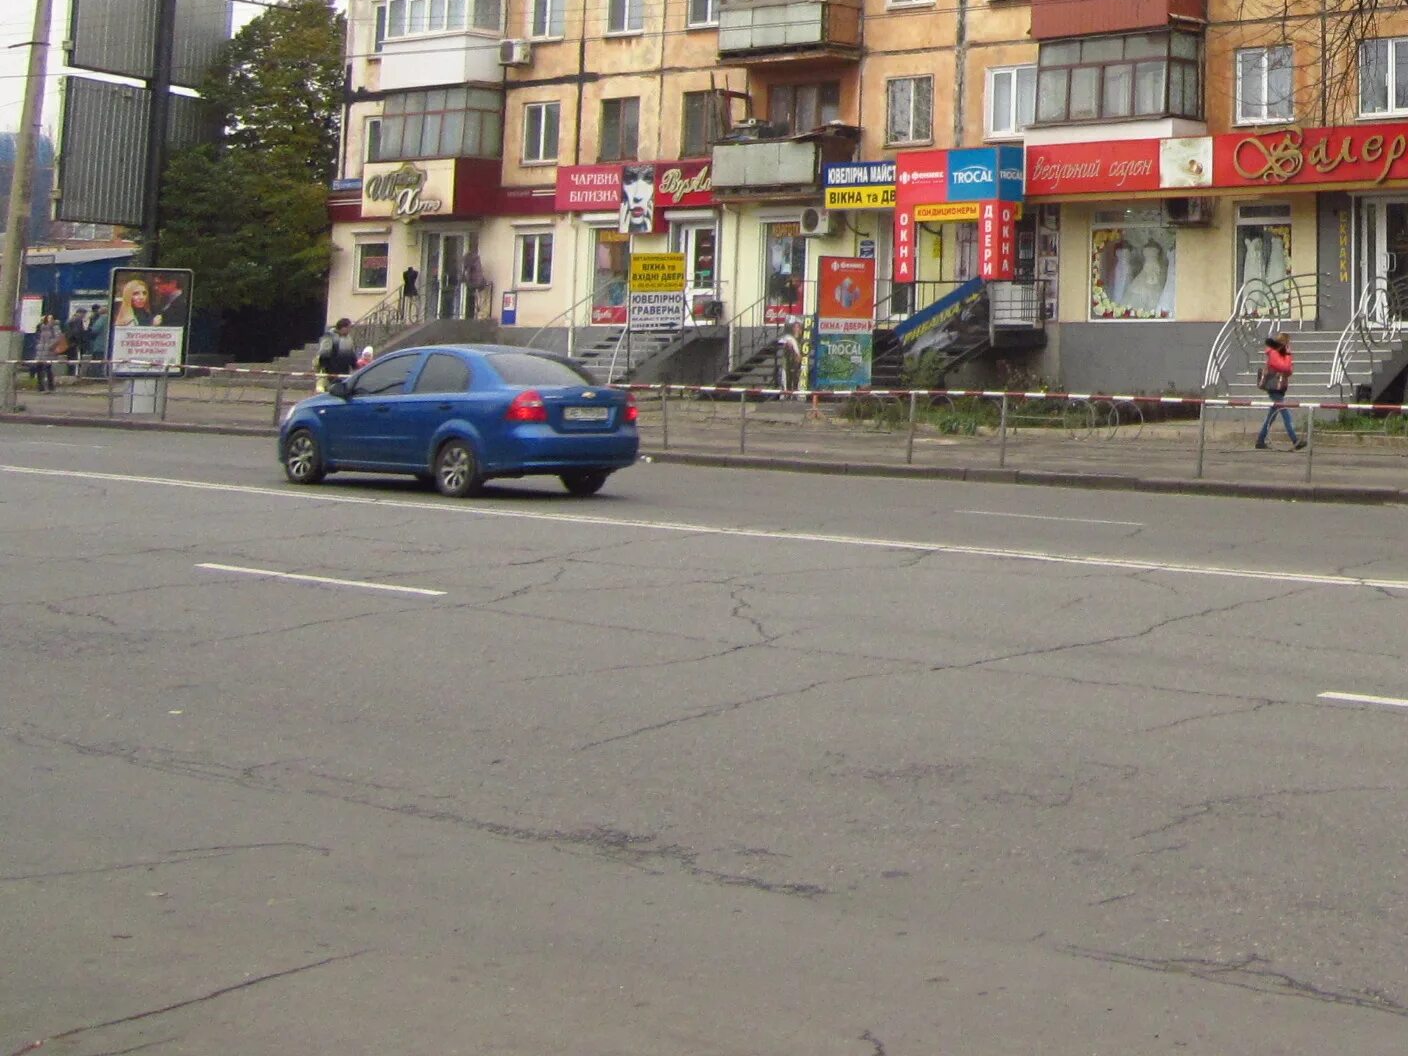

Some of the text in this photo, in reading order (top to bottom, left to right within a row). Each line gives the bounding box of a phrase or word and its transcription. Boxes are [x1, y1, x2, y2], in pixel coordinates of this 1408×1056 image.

[571, 173, 620, 186] ЧАРІВНА
[827, 166, 870, 184] ЮВЕЛІРНА
[952, 170, 993, 184] TROCAL
[1032, 157, 1153, 189] весільний салон
[570, 190, 619, 202] БІЛИЗНА
[829, 190, 863, 205] ВІКНА
[867, 192, 878, 204] та
[917, 207, 977, 217] КОНДИЦИОНЕРЫ
[899, 213, 909, 274] ОКНА
[983, 205, 993, 275] ДВЕРИ
[1002, 209, 1010, 272] ОКНА
[632, 273, 684, 282] ВХІДНІ ДВЕРІ
[631, 306, 680, 315] ГРАВЕРНА
[828, 344, 861, 355] TROCAL
